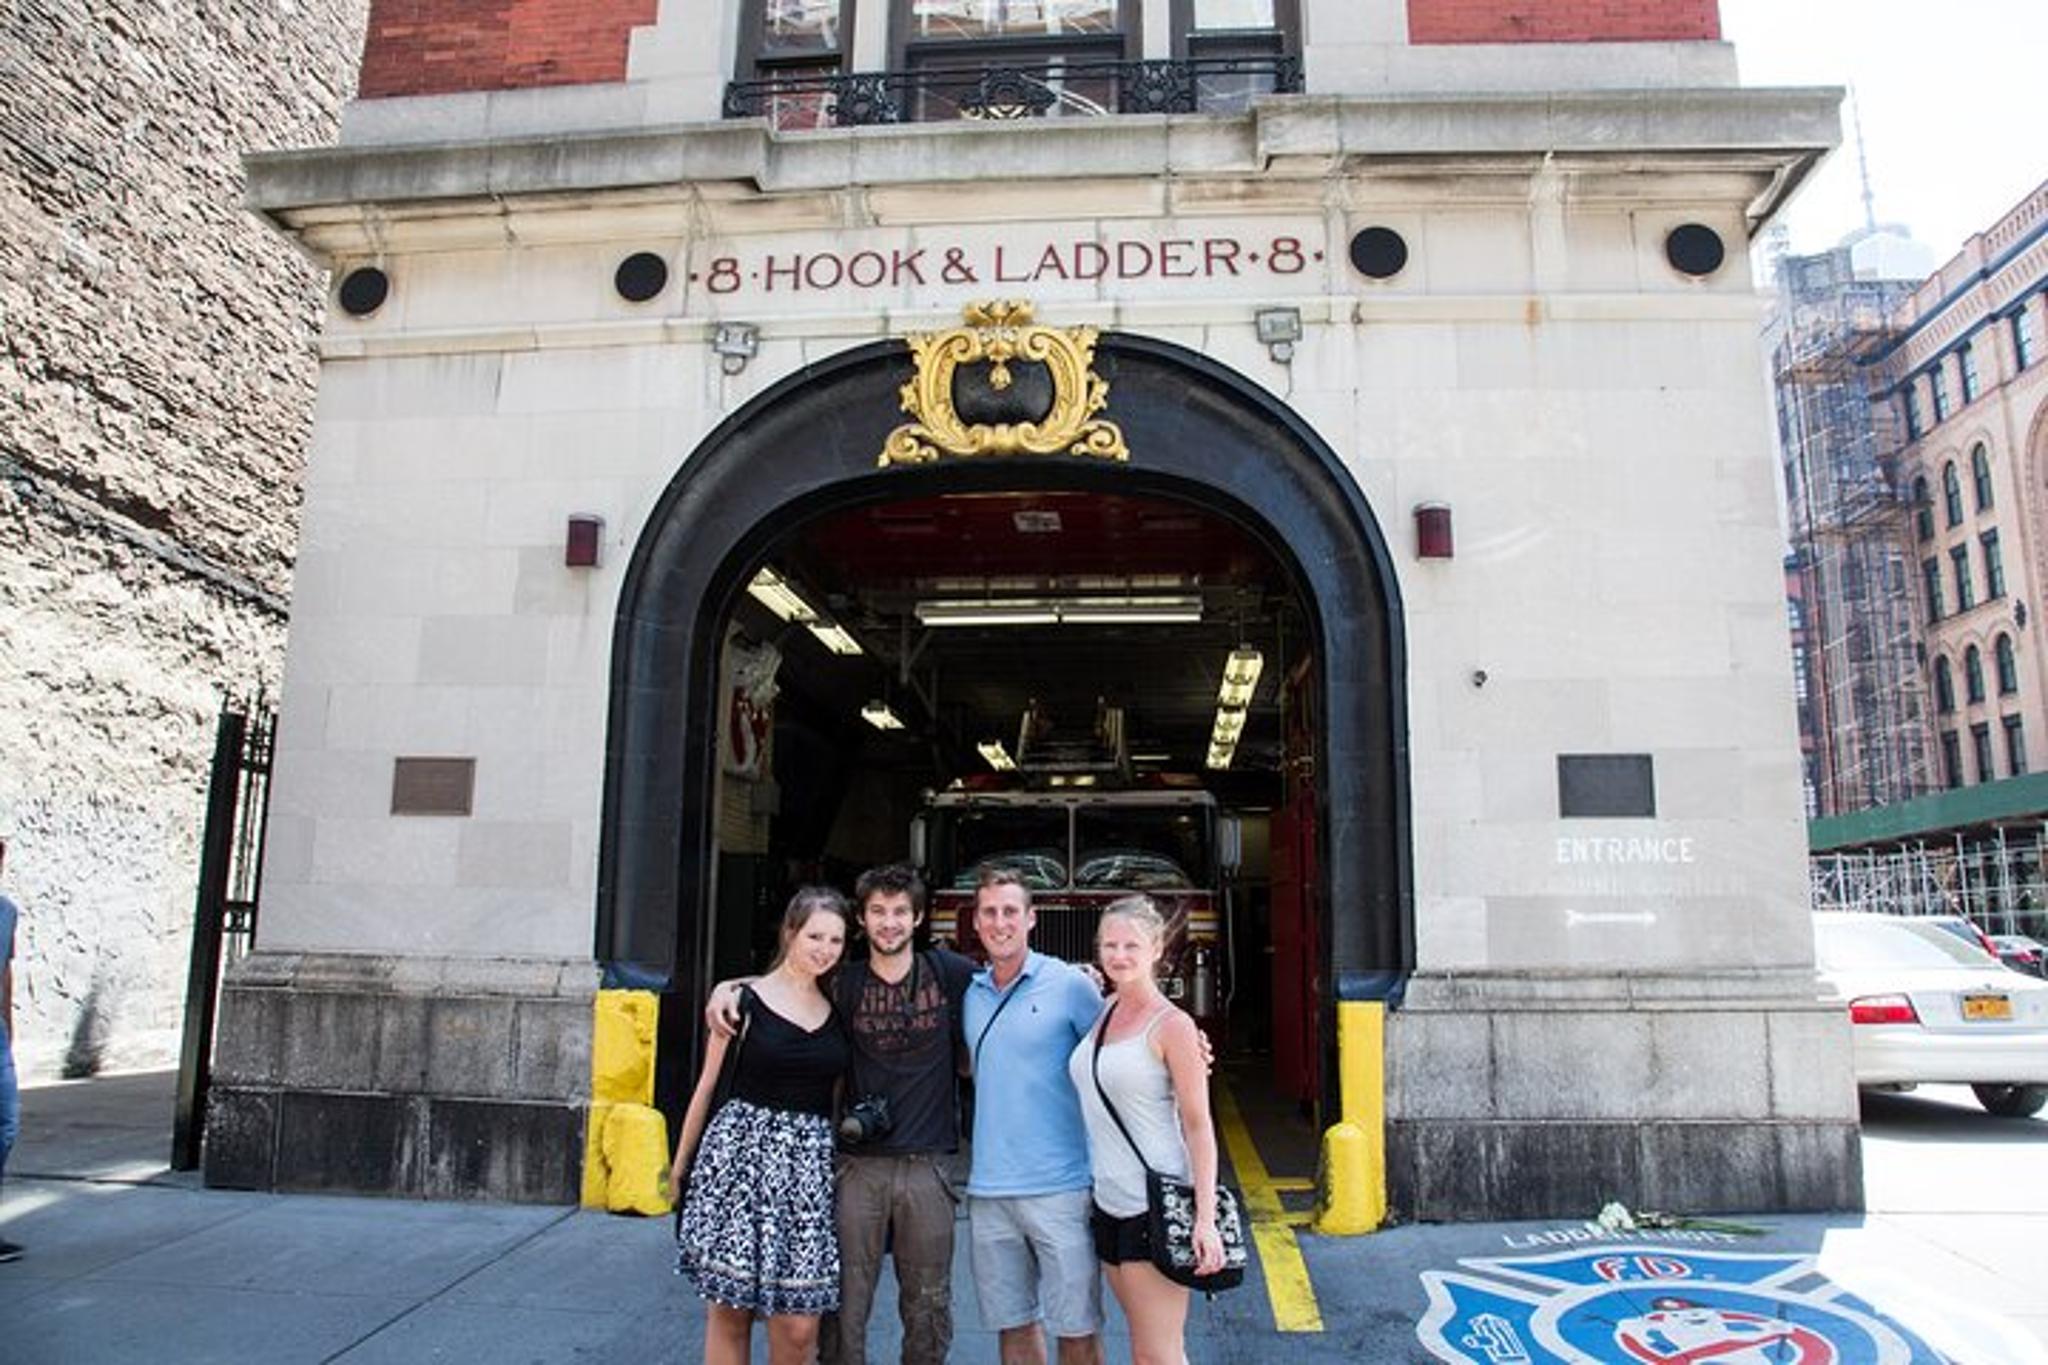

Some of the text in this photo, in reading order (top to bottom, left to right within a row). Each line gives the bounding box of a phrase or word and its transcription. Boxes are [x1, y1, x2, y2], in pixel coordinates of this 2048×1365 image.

[765, 249, 926, 291] HOOK
[940, 247, 979, 284] &
[995, 238, 1241, 283] LADDER
[1556, 837, 1695, 864] ENTRANCE
